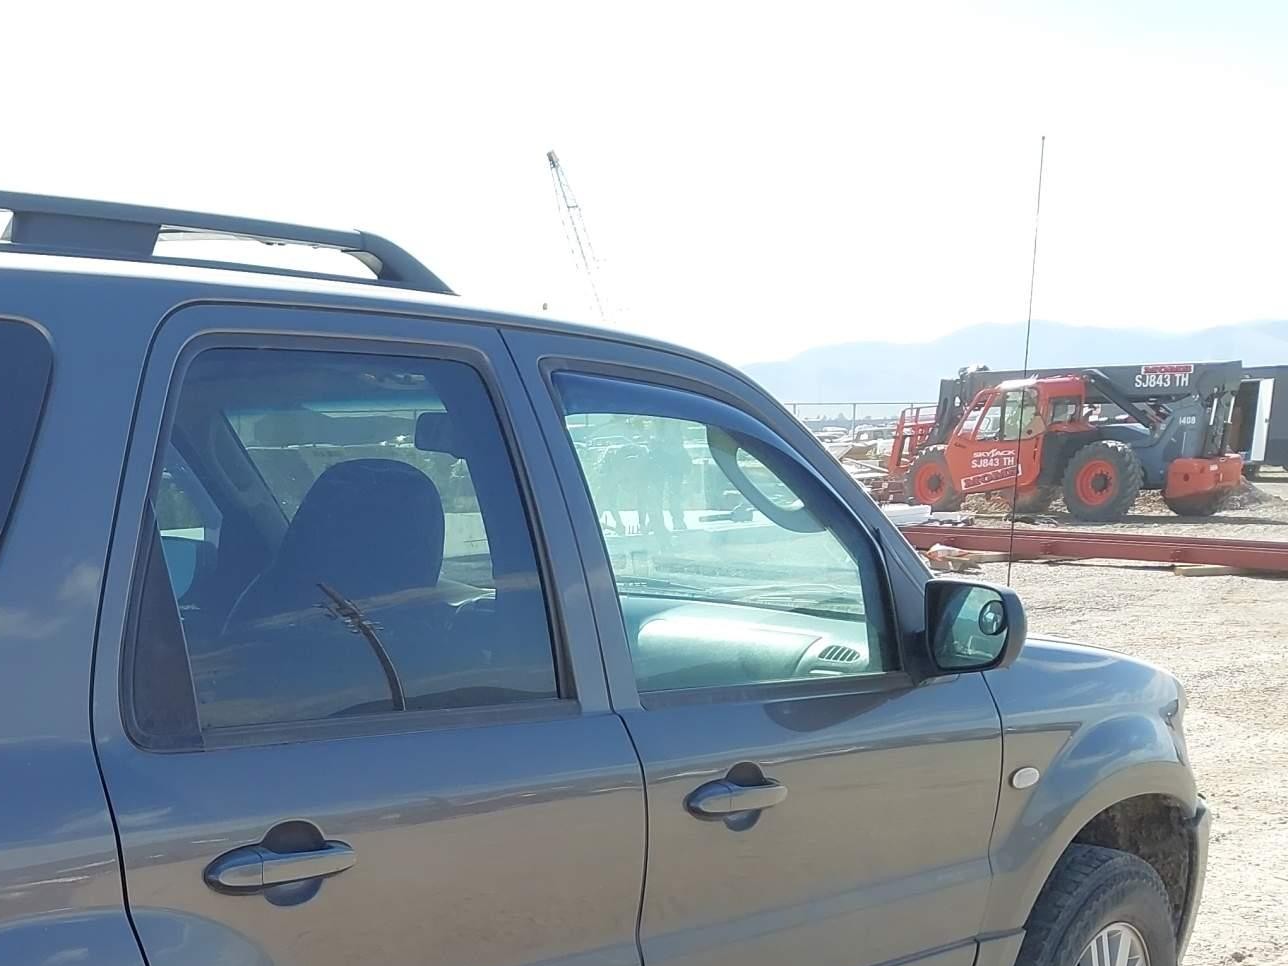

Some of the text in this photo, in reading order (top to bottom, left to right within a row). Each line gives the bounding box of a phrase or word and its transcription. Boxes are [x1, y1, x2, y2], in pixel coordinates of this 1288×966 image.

[1134, 373, 1189, 388] SJ843 TH
[972, 448, 1016, 458] SKYJACK
[971, 456, 1015, 468] SJ843 TH
